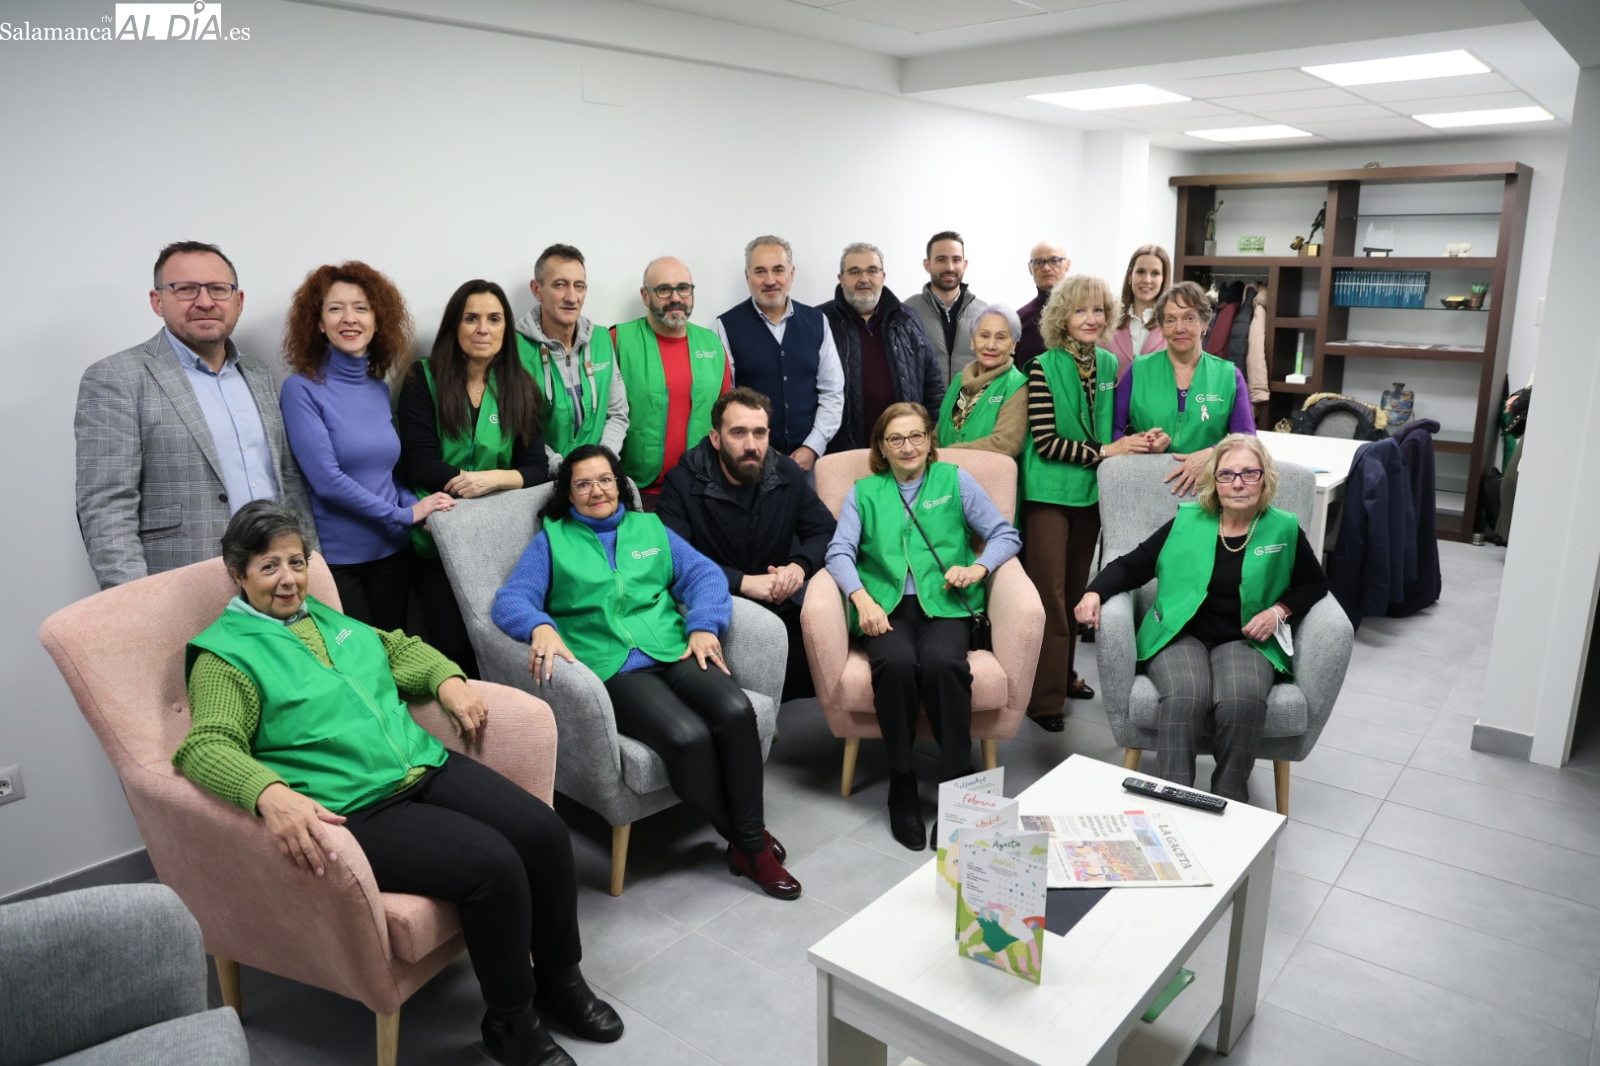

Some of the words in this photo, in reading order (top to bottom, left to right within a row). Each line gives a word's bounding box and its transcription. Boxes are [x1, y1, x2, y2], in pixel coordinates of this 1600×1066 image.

[962, 793, 997, 808] Febrero
[992, 839, 1021, 852] Agosto
[1158, 824, 1172, 836] LA
[1166, 836, 1192, 869] GACETA
